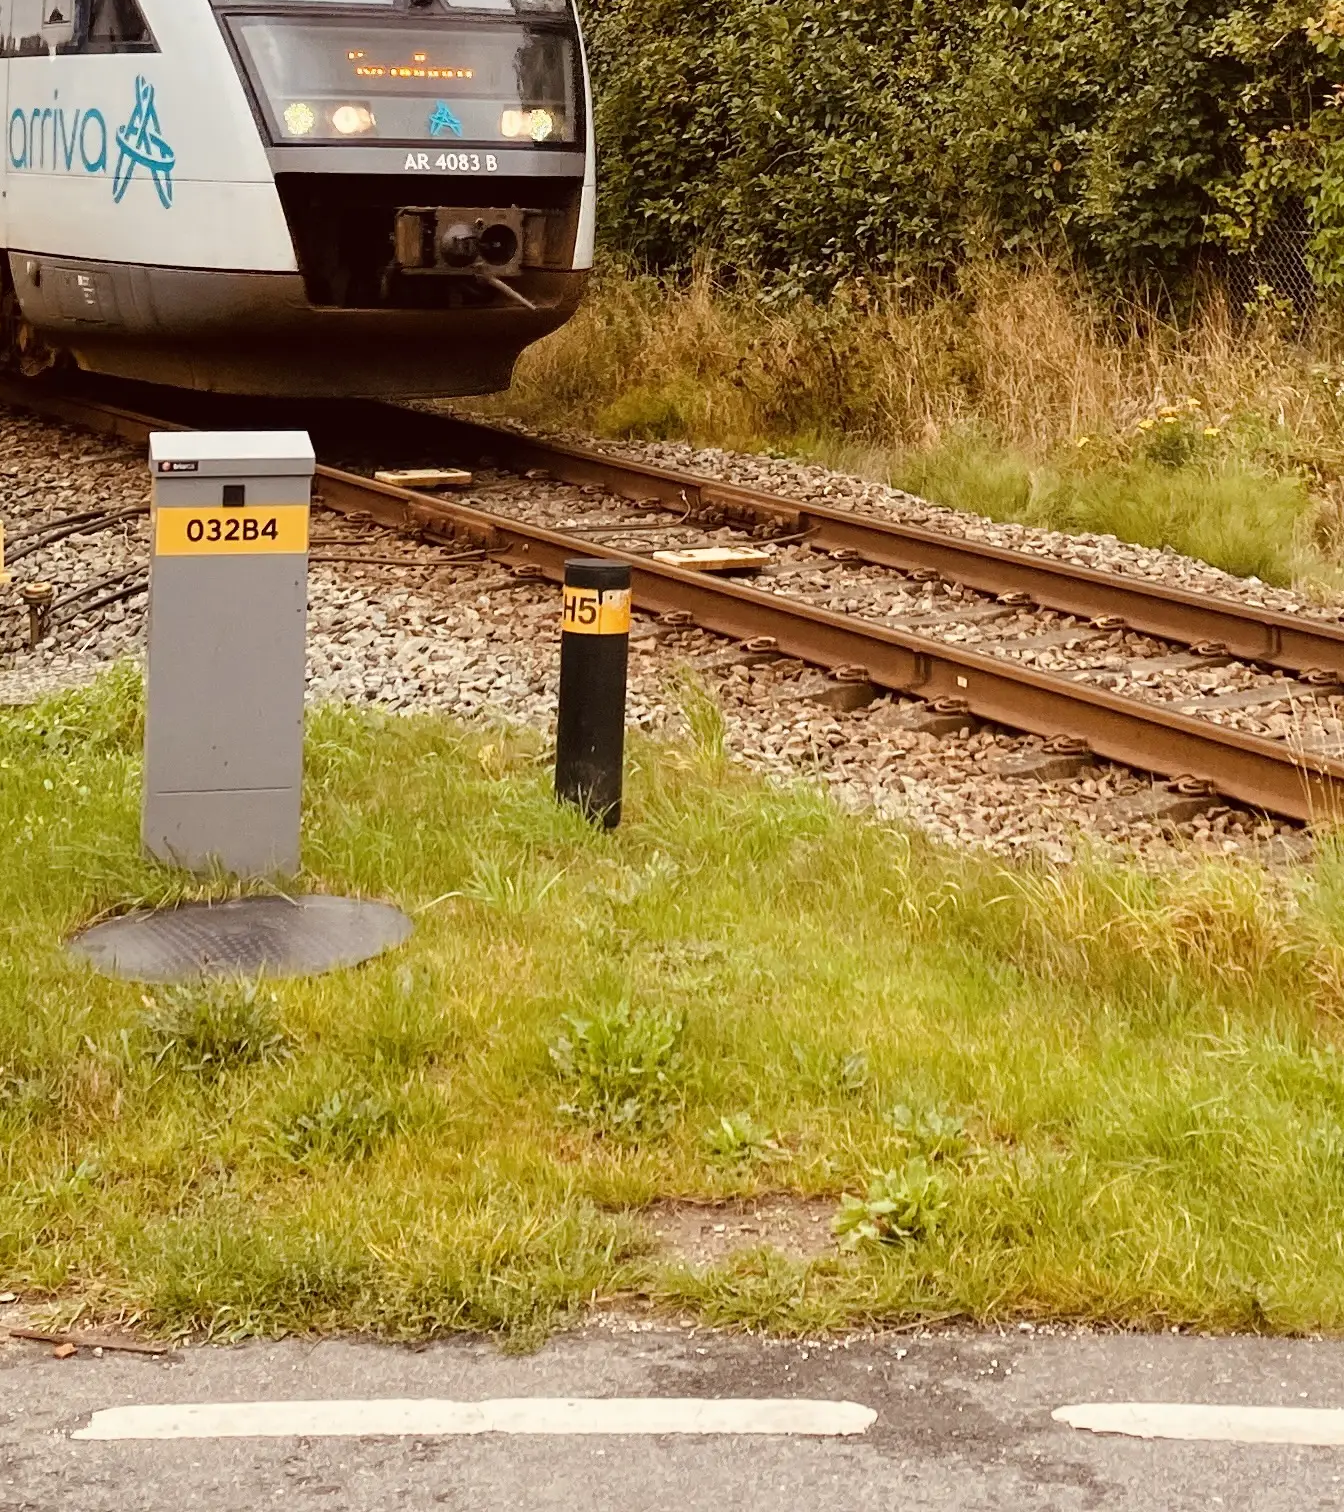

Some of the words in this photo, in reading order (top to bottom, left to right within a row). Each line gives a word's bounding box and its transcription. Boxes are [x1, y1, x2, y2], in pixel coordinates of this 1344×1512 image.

[9, 88, 106, 173] arriva
[404, 152, 431, 171] AR
[434, 152, 481, 171] 4083
[485, 154, 498, 172] B
[186, 517, 279, 543] 032B4
[563, 593, 597, 625] H5
